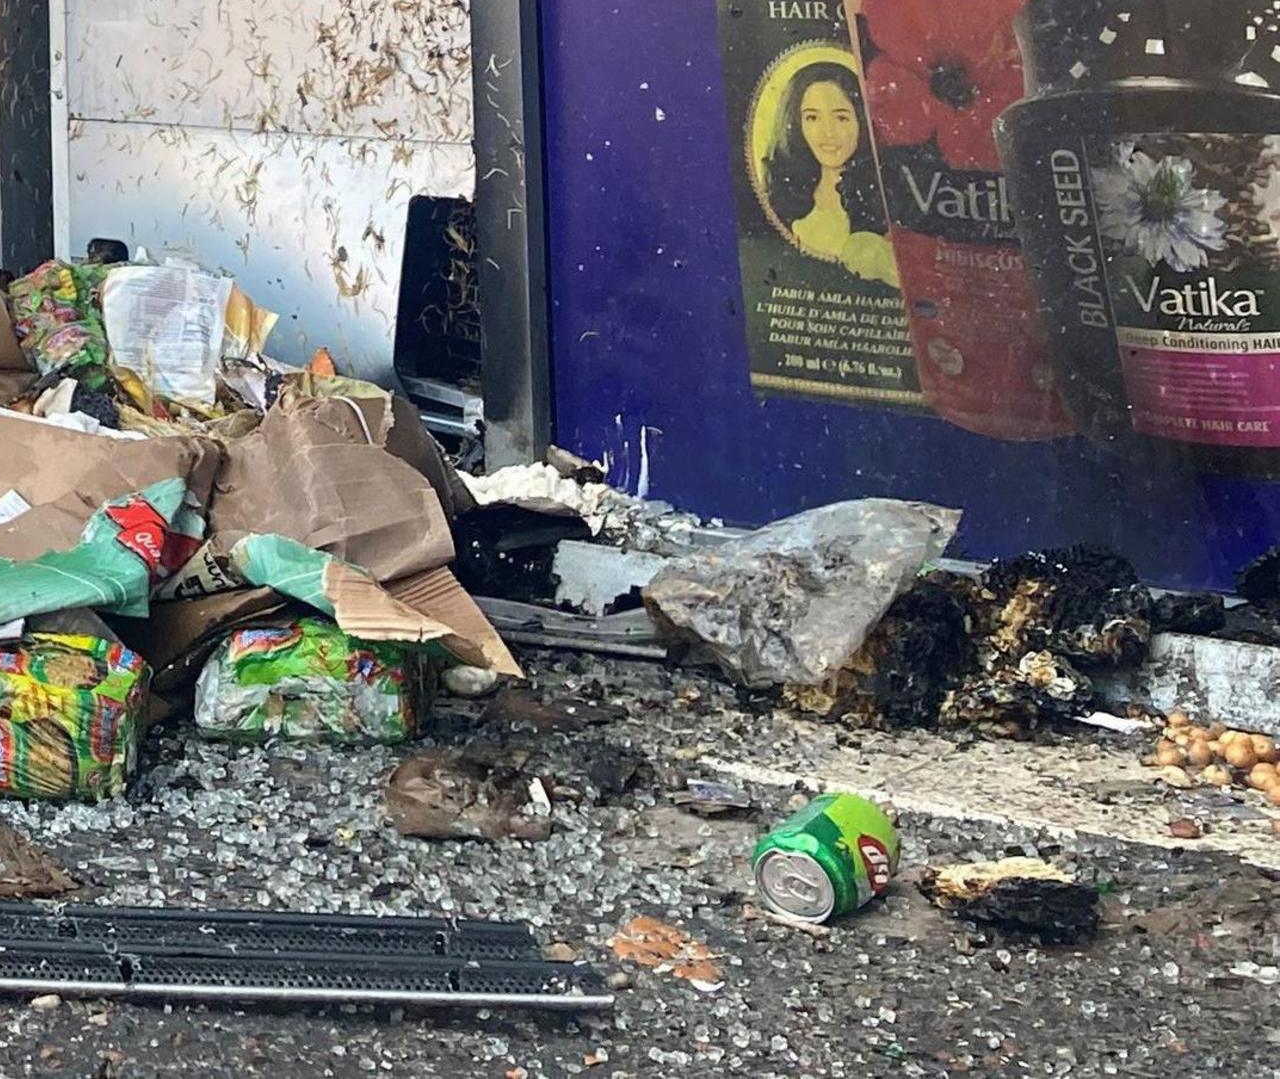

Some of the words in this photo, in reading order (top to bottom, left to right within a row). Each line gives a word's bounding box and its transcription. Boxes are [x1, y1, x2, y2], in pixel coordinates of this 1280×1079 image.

[768, 0, 828, 20] HAIR
[1050, 149, 1089, 227] SEED
[1063, 234, 1109, 328] BLACK
[1125, 275, 1262, 317] Vatika
[1162, 335, 1249, 352] Conditioning
[1236, 420, 1270, 433] CARE
